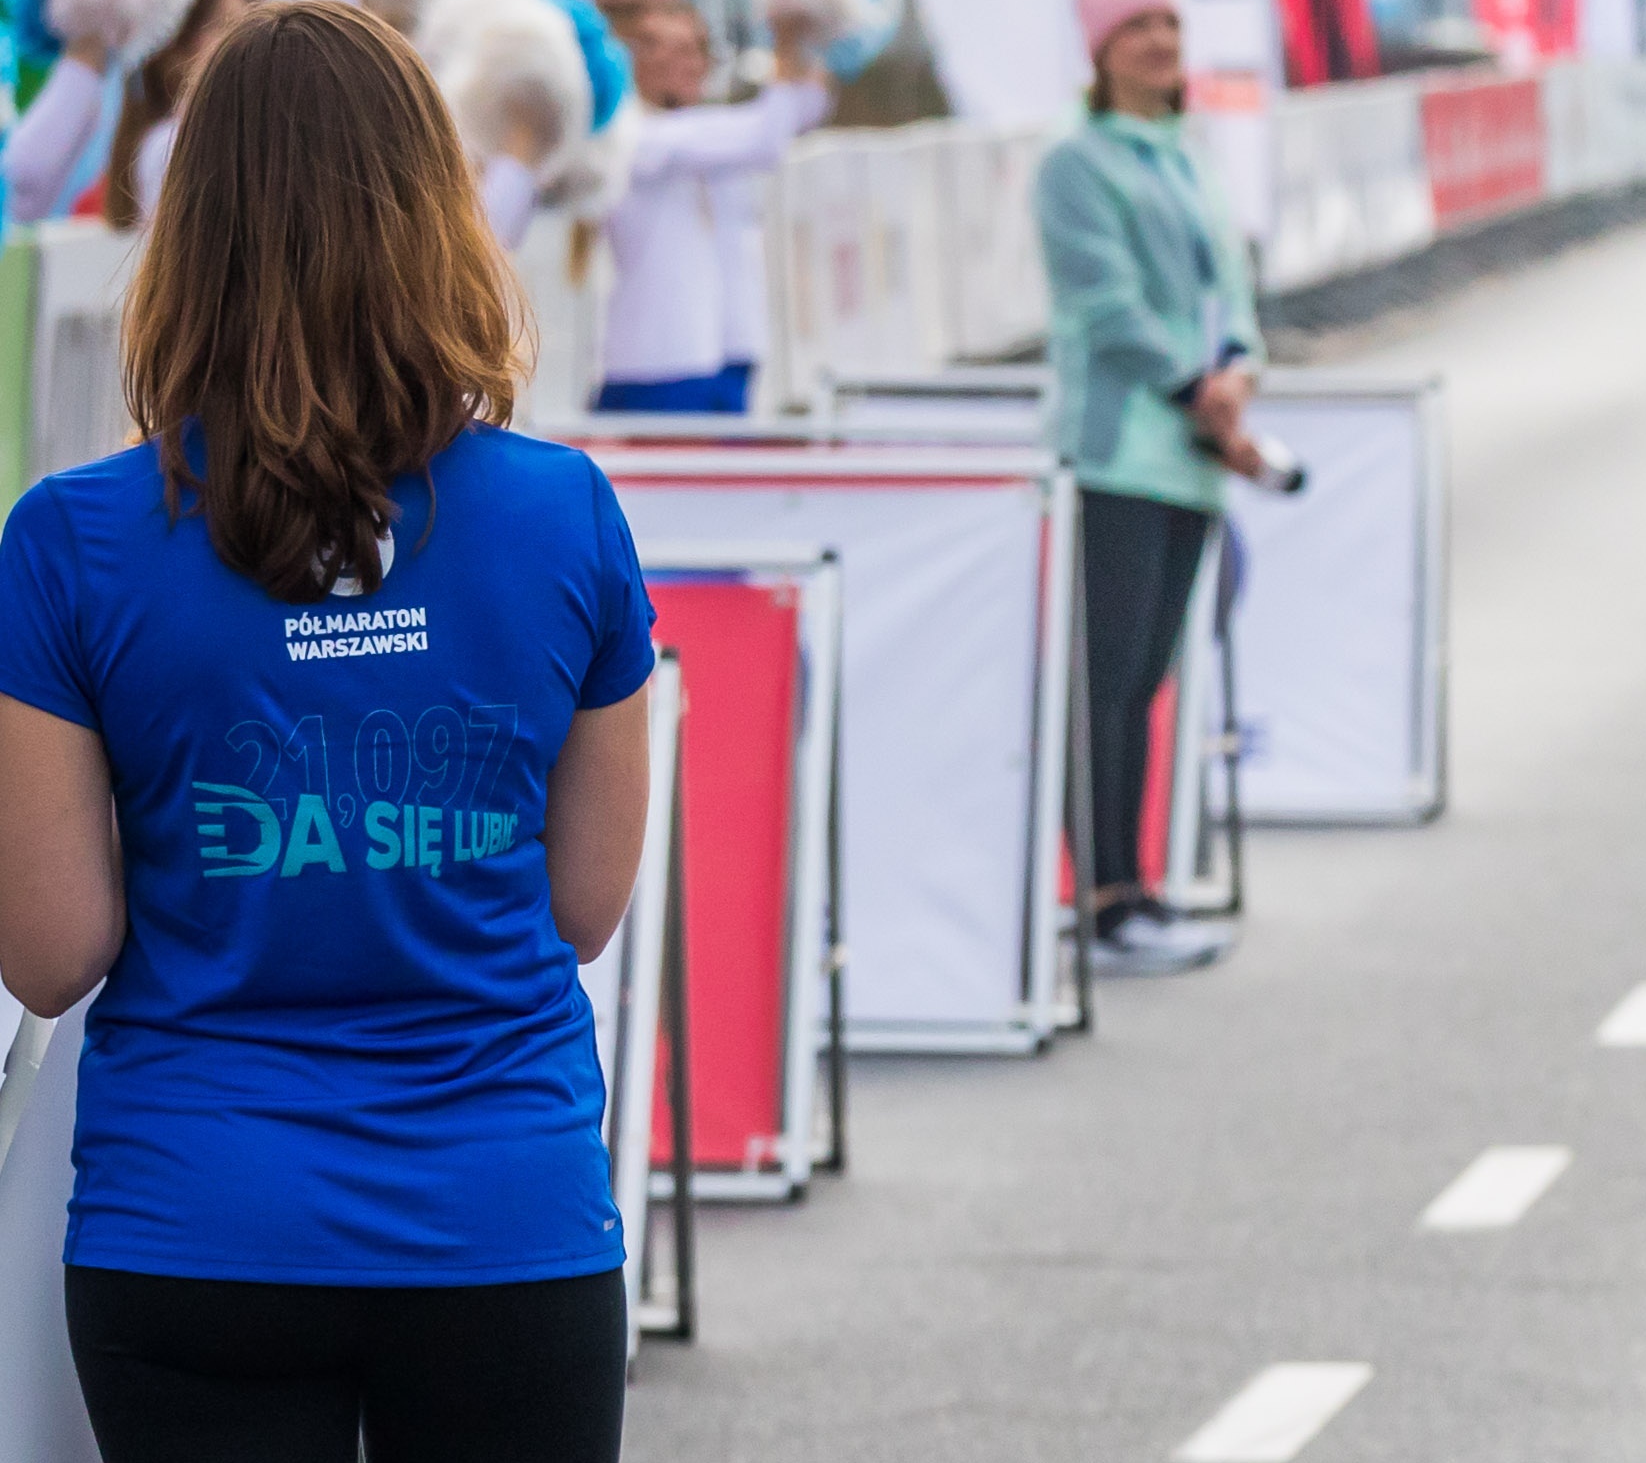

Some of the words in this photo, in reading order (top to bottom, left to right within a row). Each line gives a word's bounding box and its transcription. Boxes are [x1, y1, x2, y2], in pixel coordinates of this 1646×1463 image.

[284, 607, 426, 637] PÓŁMARATON
[286, 631, 428, 661] WARSZAWSKI
[364, 800, 443, 879] SIĘ
